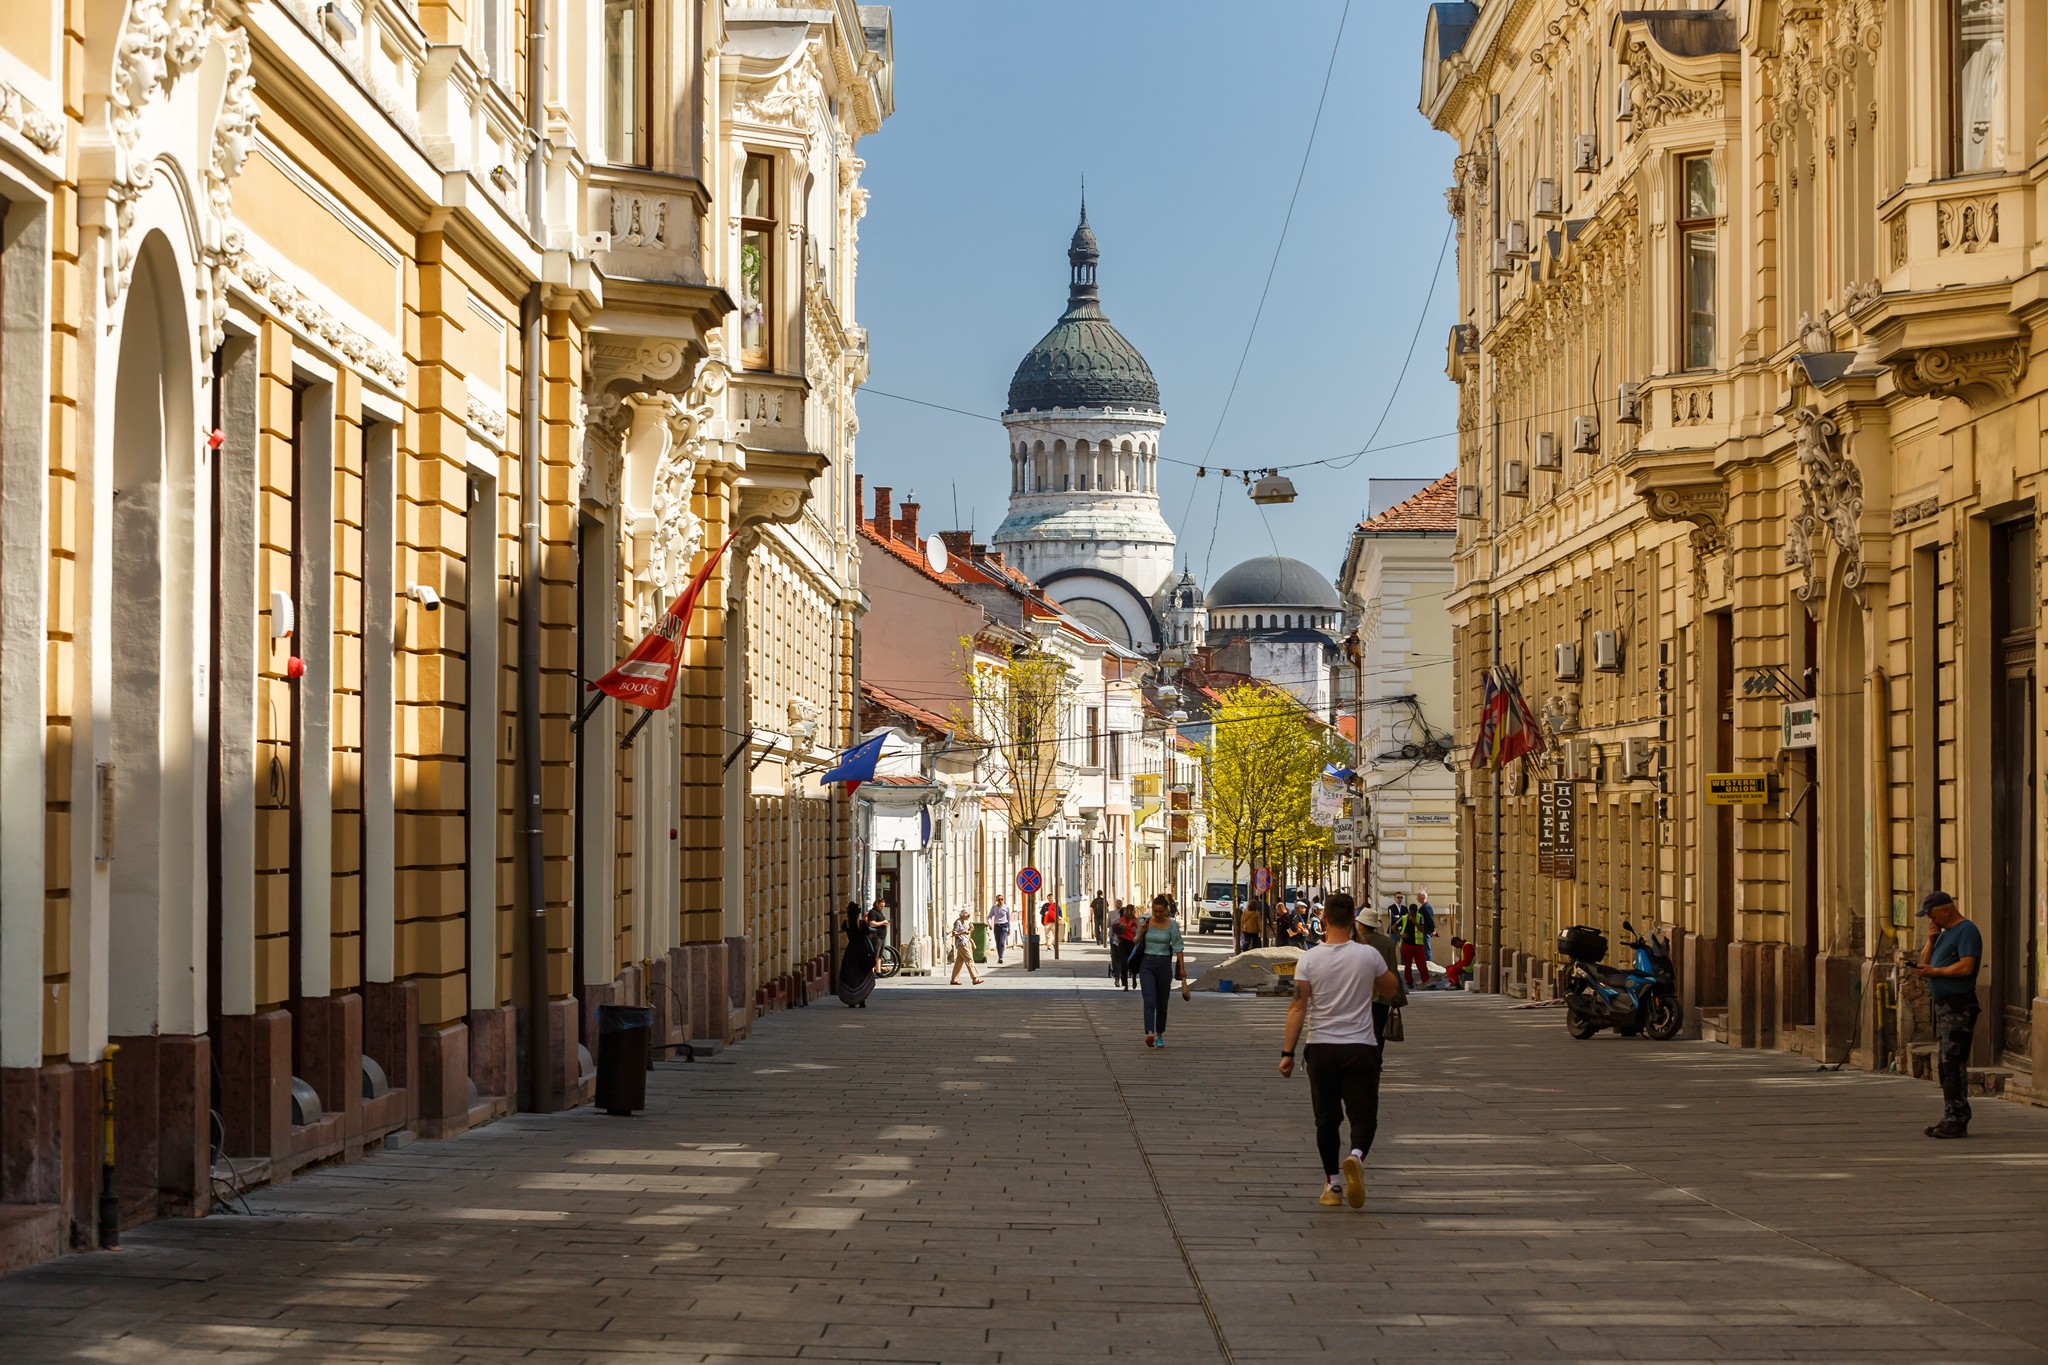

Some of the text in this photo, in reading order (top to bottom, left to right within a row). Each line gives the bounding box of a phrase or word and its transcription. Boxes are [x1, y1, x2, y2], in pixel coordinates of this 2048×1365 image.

[619, 682, 658, 696] BOOKS
[1711, 779, 1756, 787] WESTERN
[1541, 783, 1553, 838] HOTEL
[1556, 787, 1572, 843] HOTEL
